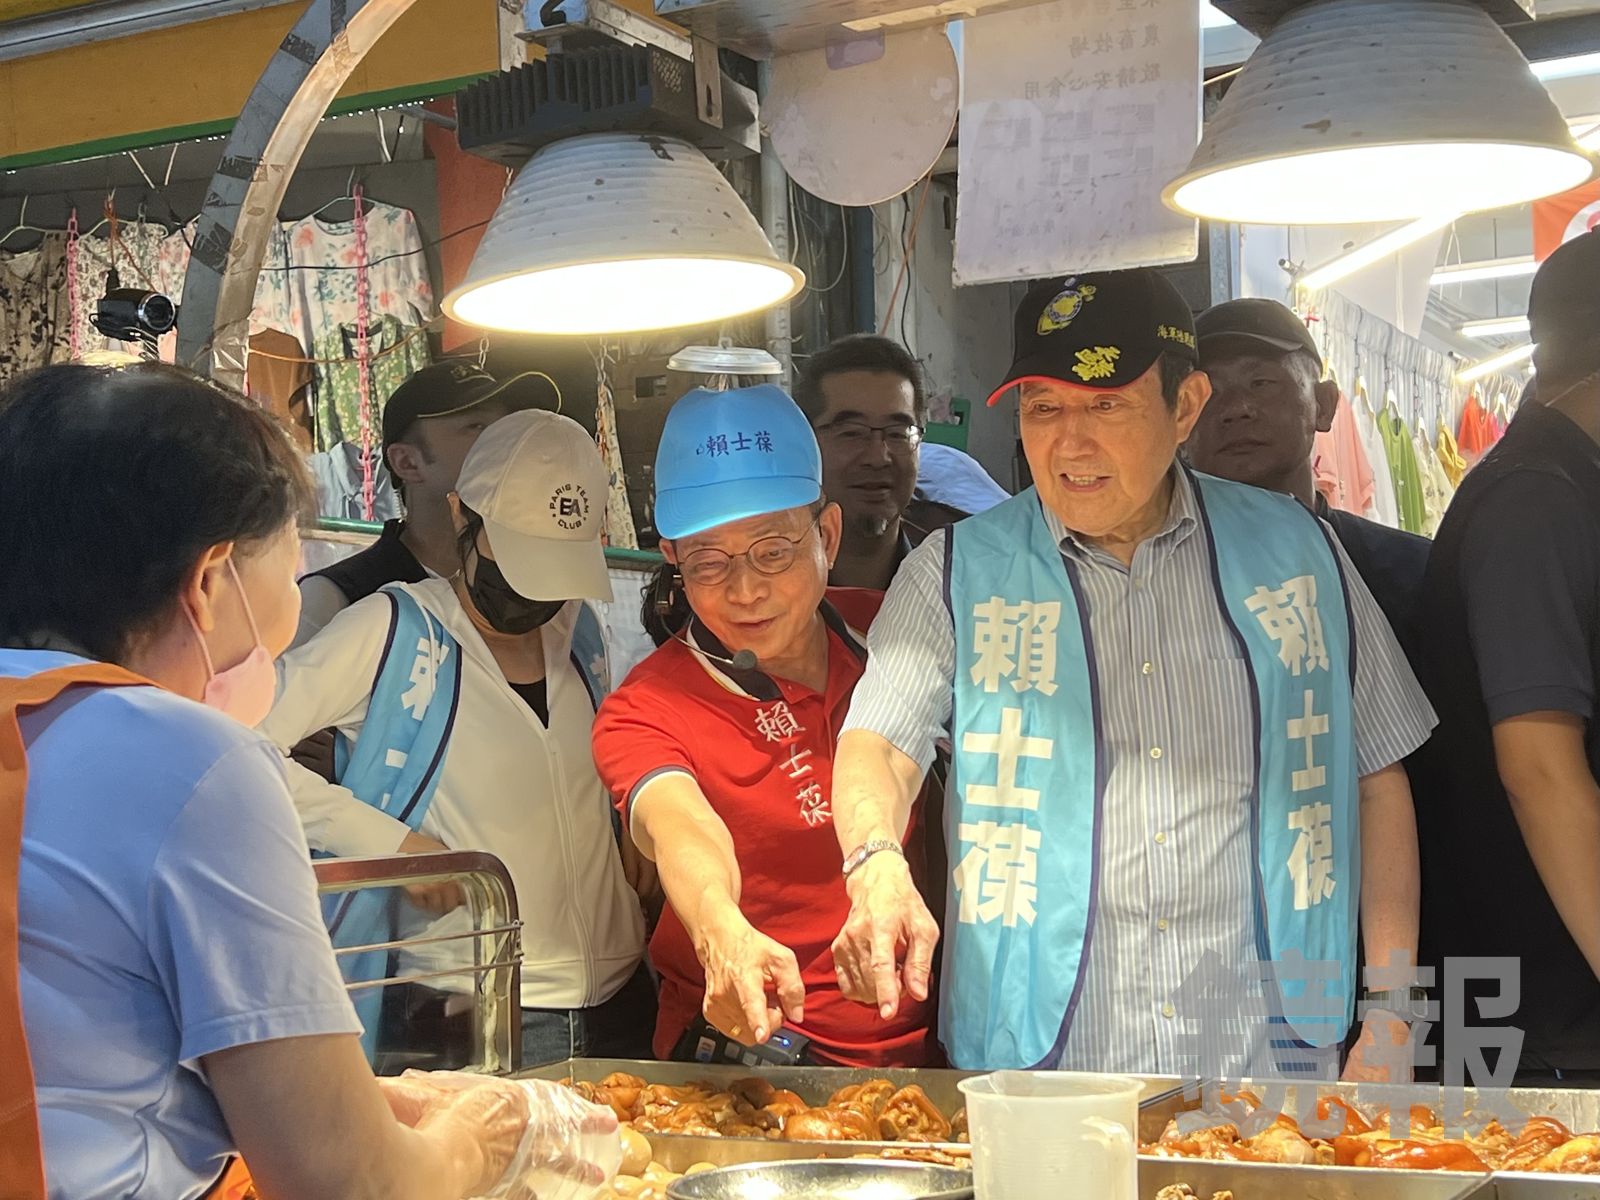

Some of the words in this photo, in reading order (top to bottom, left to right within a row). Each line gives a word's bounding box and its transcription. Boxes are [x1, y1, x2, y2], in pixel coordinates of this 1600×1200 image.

[706, 430, 774, 458] 賴士葆
[549, 483, 572, 510] PARIS
[576, 485, 590, 514] TEAM
[557, 519, 582, 530] CLUB
[754, 701, 833, 828] 賴士葆
[953, 596, 1062, 928] 賴士葆
[1244, 575, 1337, 911] 賴士葆
